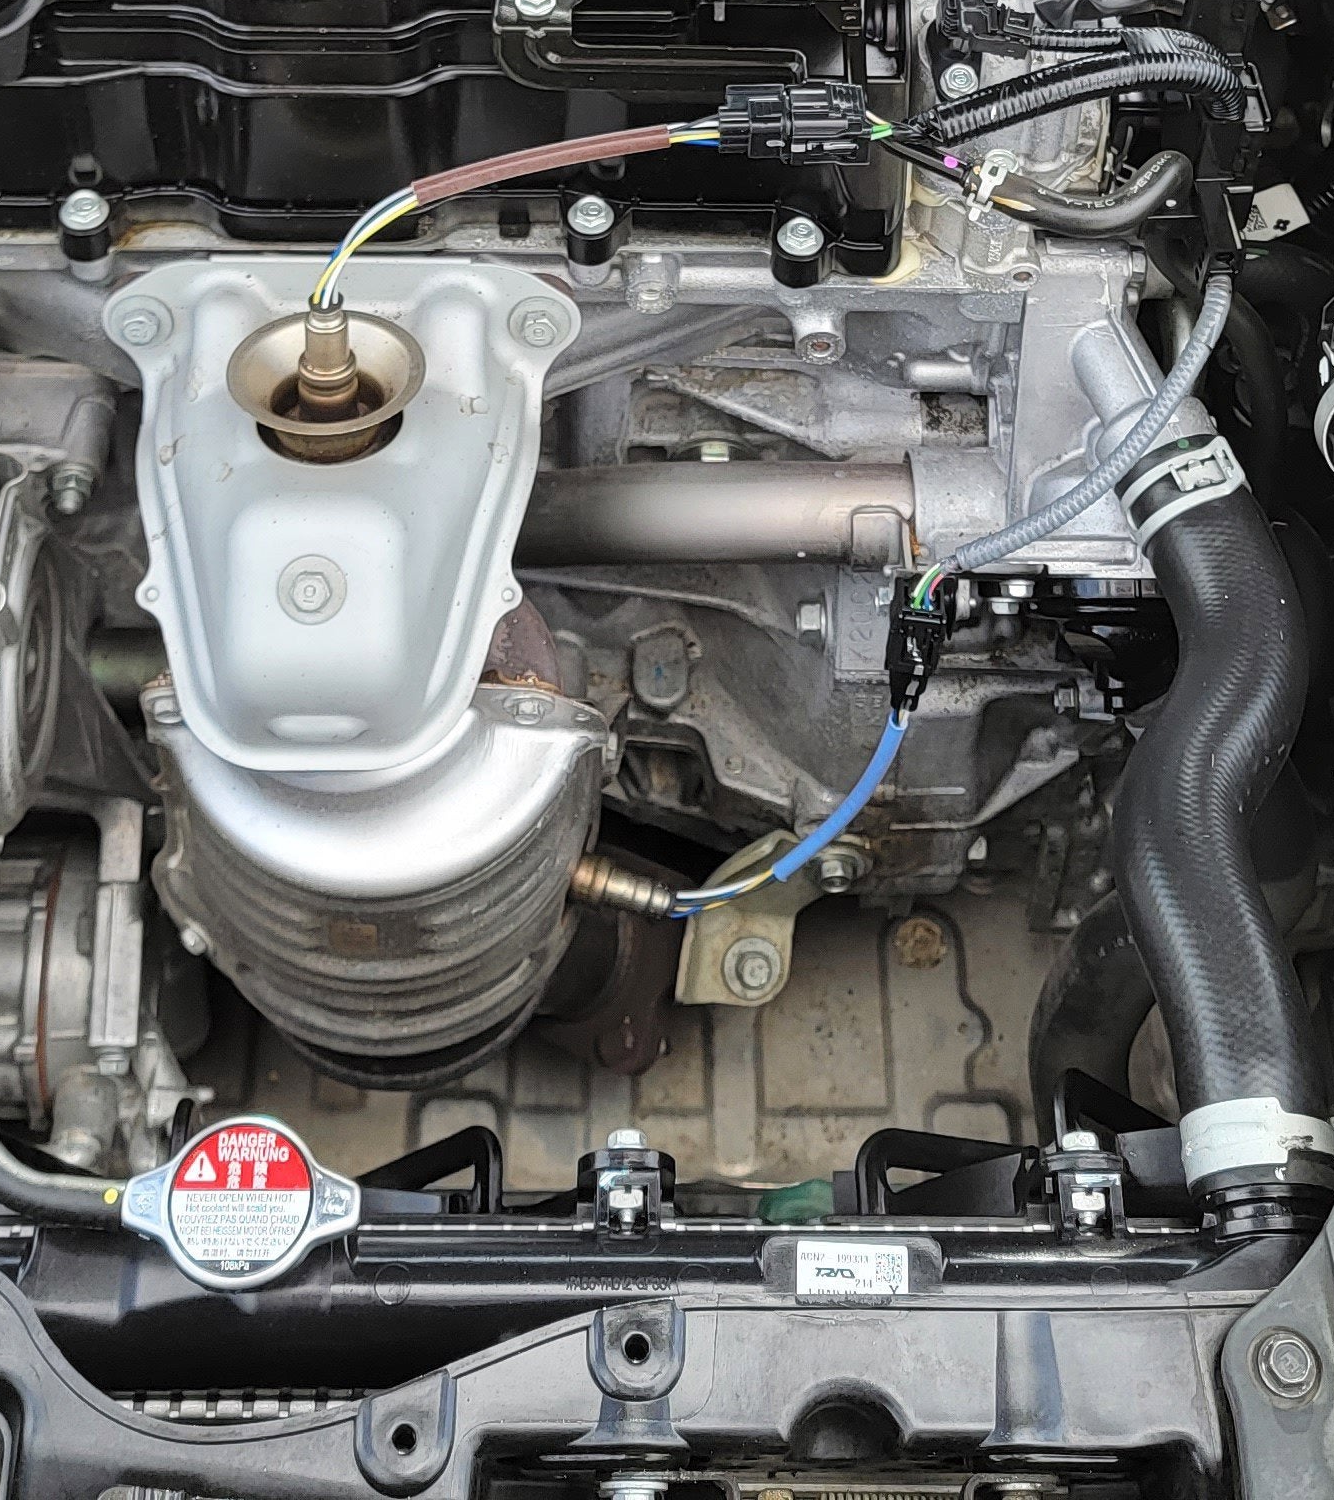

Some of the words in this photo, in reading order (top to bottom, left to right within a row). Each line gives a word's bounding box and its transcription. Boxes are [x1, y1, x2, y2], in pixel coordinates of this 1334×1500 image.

[218, 1132, 277, 1147] DANGER
[218, 1147, 290, 1162] WARNUNG
[186, 1193, 217, 1203] NEVER
[218, 1193, 244, 1203] OPEN
[246, 1193, 273, 1203] WHEN
[185, 1204, 200, 1213] Hot
[201, 1204, 230, 1213] coolant
[231, 1204, 244, 1213] will
[246, 1204, 267, 1213] scald
[220, 1214, 237, 1224] PAS
[238, 1214, 268, 1225] QUAND
[270, 1214, 300, 1224] CHAUD
[243, 1226, 267, 1235] MOTOR
